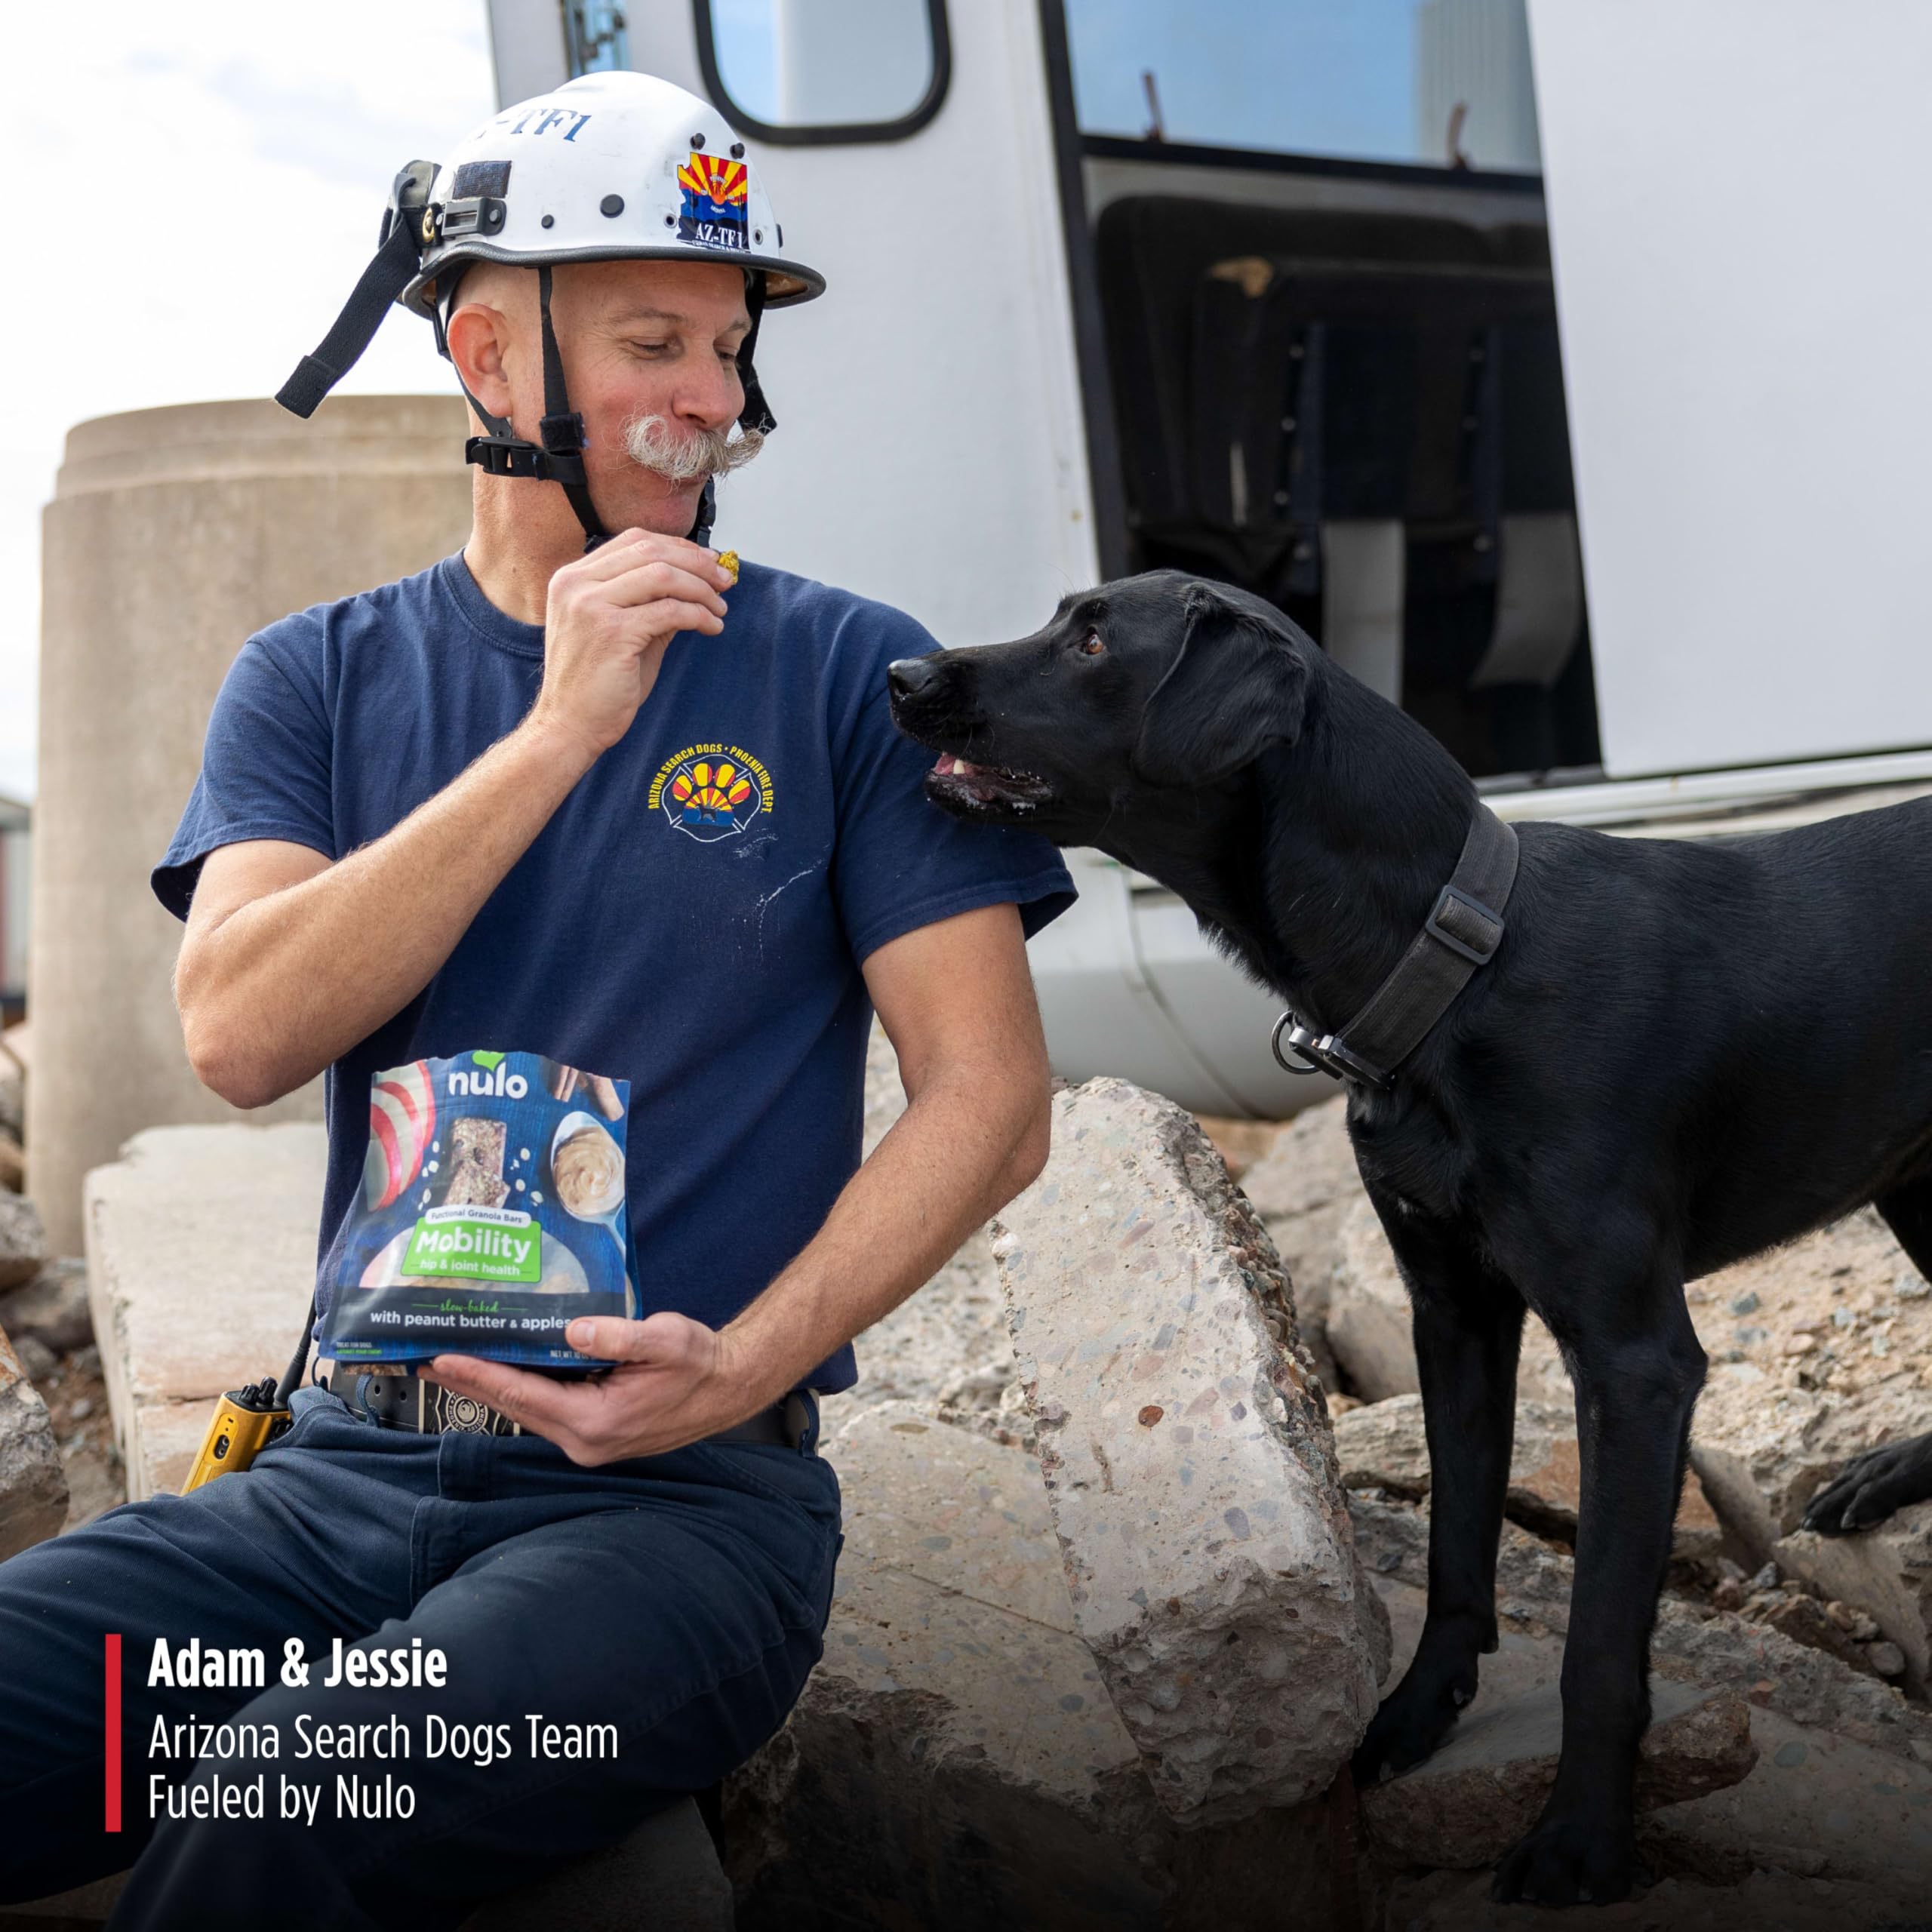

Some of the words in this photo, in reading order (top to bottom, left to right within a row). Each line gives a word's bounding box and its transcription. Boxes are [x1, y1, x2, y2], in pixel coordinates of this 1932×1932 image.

[695, 223, 743, 249] AZ-TF1
[648, 772, 666, 810] ARIZONA
[660, 746, 696, 774] SEARCH
[695, 743, 723, 754] DOGS
[729, 746, 764, 774] PHOENIX
[758, 770, 772, 789] FIRE
[448, 1062, 528, 1099] nulo
[431, 1210, 466, 1220] Functional
[468, 1210, 501, 1221] Granola
[503, 1214, 522, 1223] Bars
[416, 1226, 532, 1264] Mobility
[420, 1258, 437, 1270] hip
[439, 1259, 448, 1269] &
[451, 1260, 479, 1272] joint
[482, 1262, 520, 1276] health
[440, 1298, 500, 1314] slow-baked
[371, 1312, 401, 1324] with
[405, 1314, 456, 1327] peanut
[460, 1315, 506, 1329] butter
[509, 1319, 518, 1329] &
[521, 1316, 571, 1331] apples
